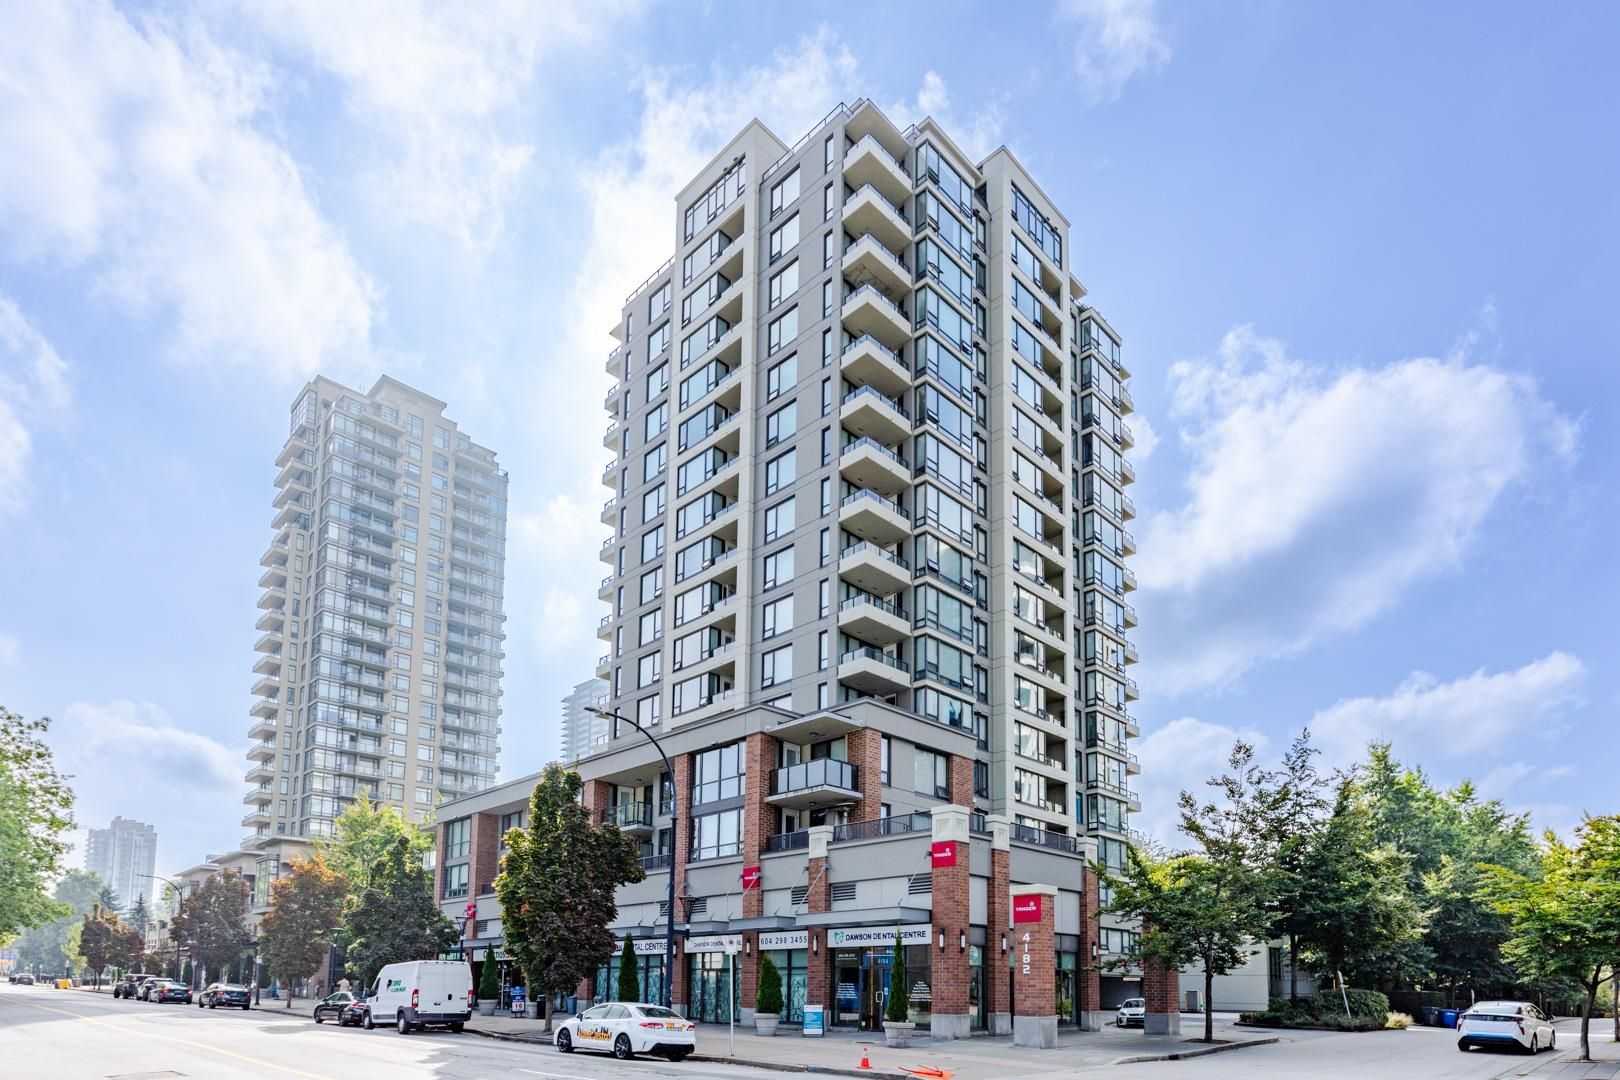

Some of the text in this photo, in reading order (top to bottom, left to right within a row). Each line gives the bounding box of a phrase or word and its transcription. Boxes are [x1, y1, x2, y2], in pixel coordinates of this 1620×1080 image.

[760, 935, 808, 945] 604 298 3455
[845, 931, 927, 941] DAWSON DENTAL CENTRE
[645, 942, 668, 951] CENTRE
[1022, 932, 1031, 975] 4182
